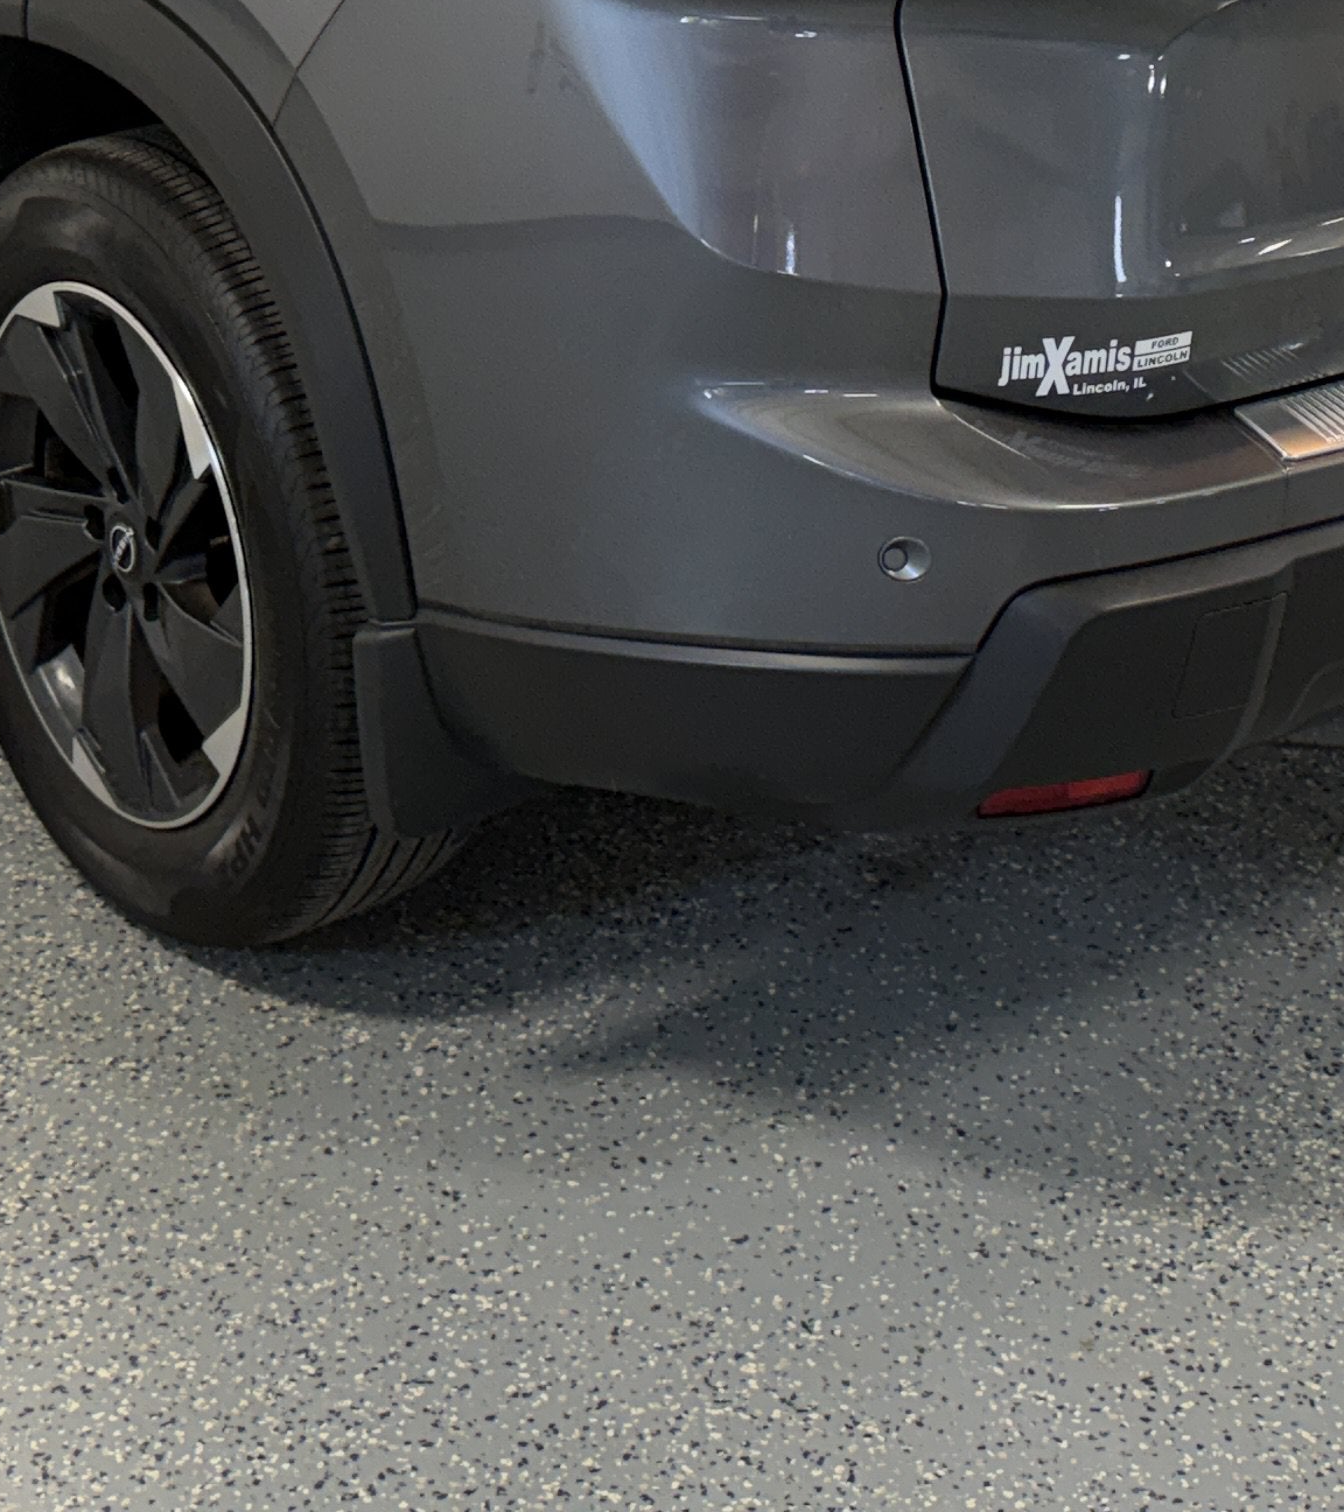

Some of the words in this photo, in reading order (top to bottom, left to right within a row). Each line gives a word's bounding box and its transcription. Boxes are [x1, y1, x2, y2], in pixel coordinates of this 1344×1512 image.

[1151, 336, 1179, 350] FORD
[998, 336, 1132, 397] jimXamis
[1137, 350, 1188, 368] LINCOLN
[1072, 380, 1131, 396] Lincoln,
[1133, 376, 1147, 389] IL
